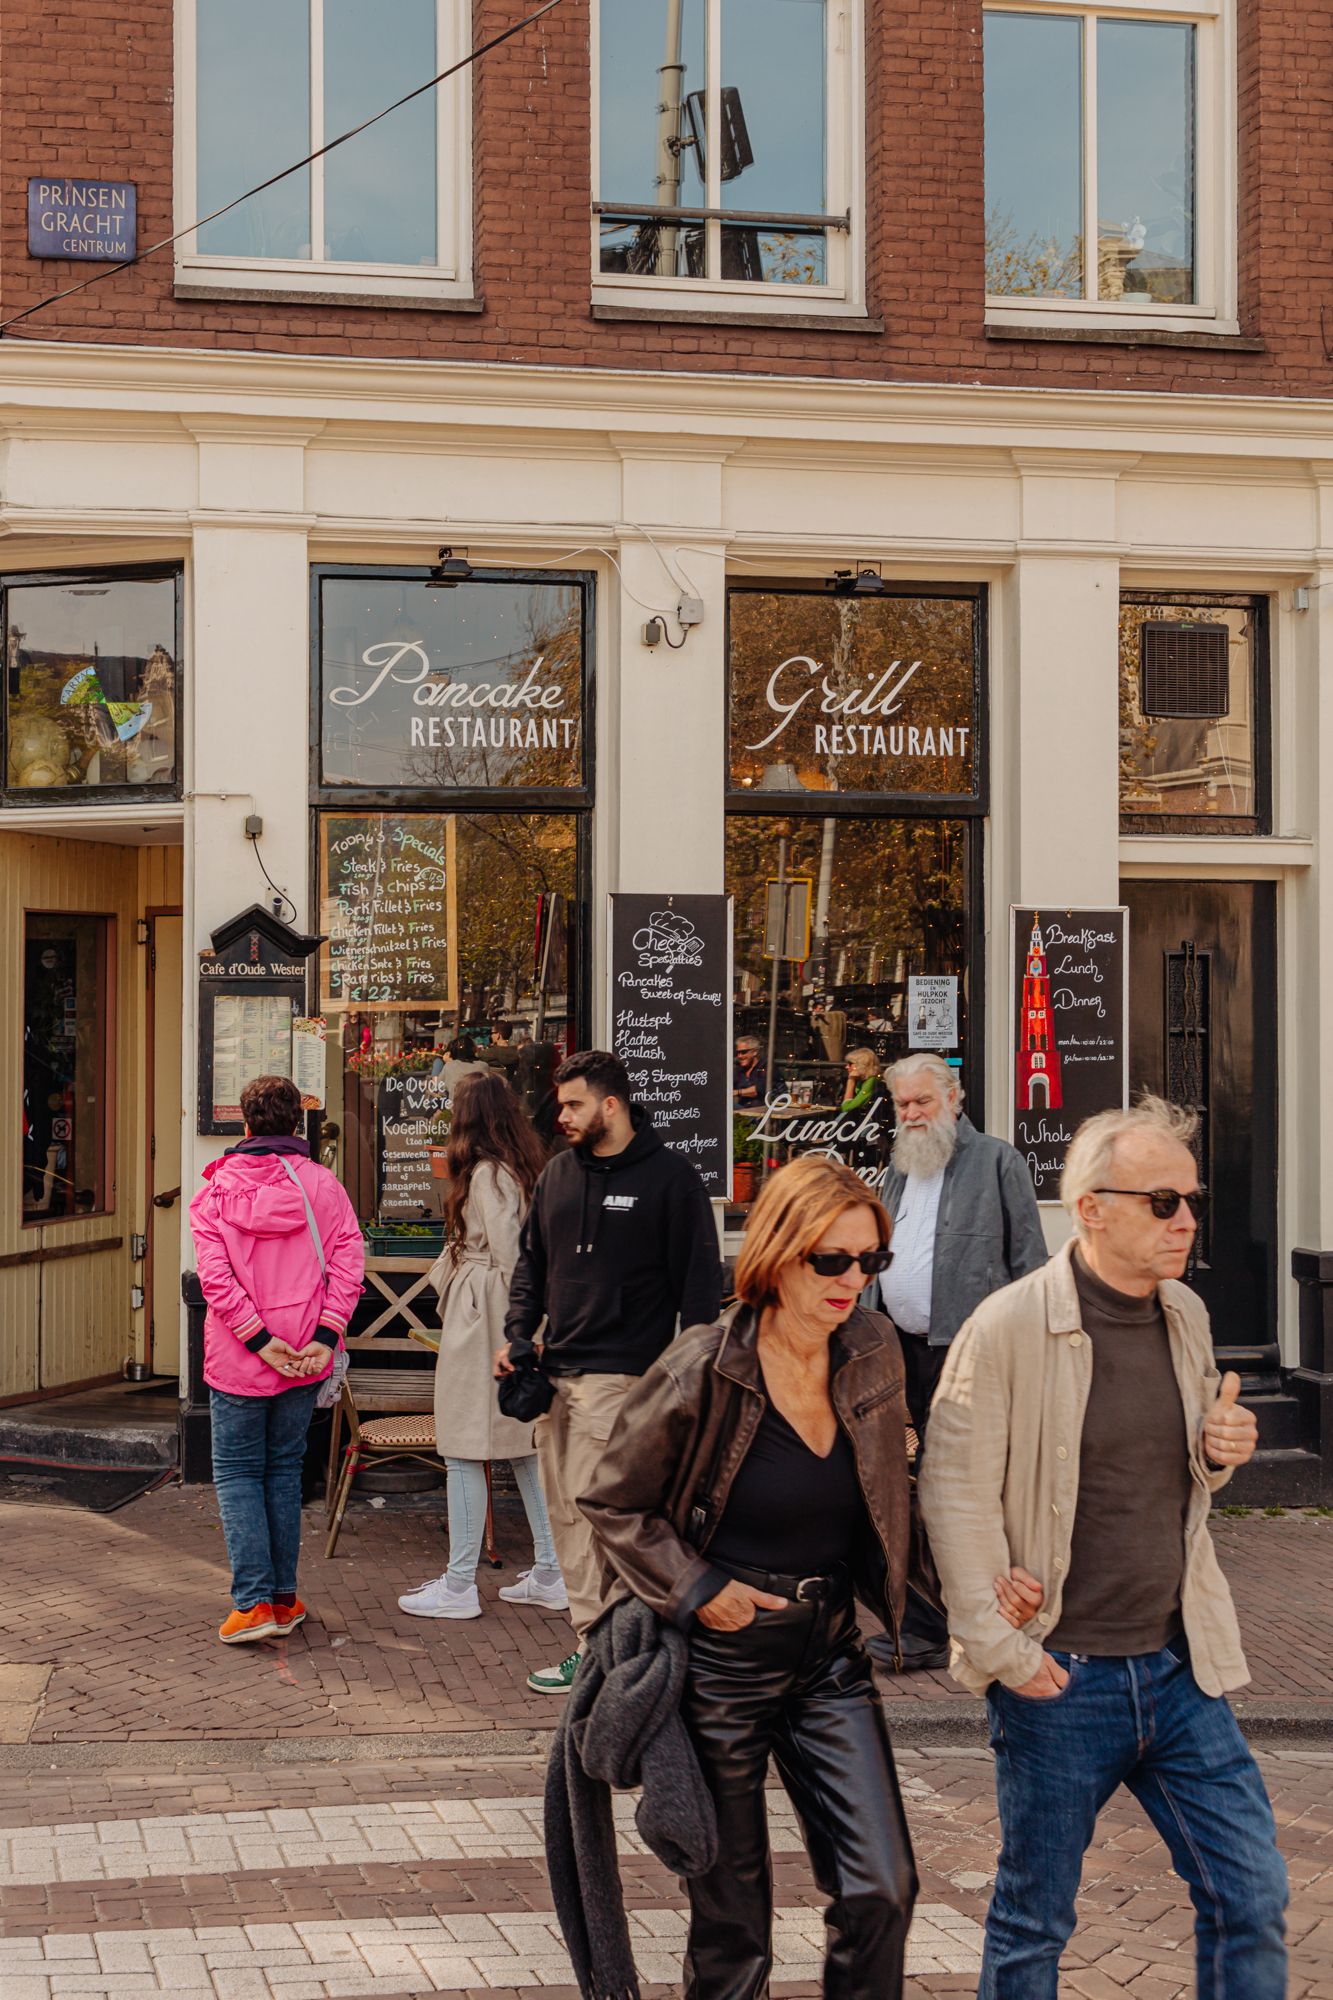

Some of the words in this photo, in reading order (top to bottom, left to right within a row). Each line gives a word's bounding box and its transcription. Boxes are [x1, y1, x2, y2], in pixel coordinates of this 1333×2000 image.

[40, 184, 125, 209] PRINSEN
[41, 211, 125, 235] GRACHT
[62, 239, 126, 254] CENTRUM
[328, 640, 565, 709] Pancake
[745, 655, 922, 750] Grill
[410, 717, 574, 748] RESTAURANT
[815, 724, 970, 757] RESTAURANT
[340, 857, 377, 874] Steak
[391, 858, 420, 873] Fries
[339, 882, 369, 895] Fish
[413, 899, 442, 914] Fries
[408, 921, 435, 934] Fries
[422, 936, 447, 949] Fries
[1045, 924, 1118, 952] Breakfast
[200, 963, 225, 975] Cafe
[229, 963, 266, 975] d'Oude
[270, 963, 306, 975] Wester
[406, 957, 431, 969] Fries
[1054, 955, 1104, 983] Lunch
[407, 970, 435, 984] Fries
[640, 988, 673, 999] Sweet
[1053, 988, 1106, 1017] Dinner
[618, 1046, 666, 1061] Goulash
[386, 1076, 404, 1092] De
[406, 1076, 445, 1093] Oude
[627, 1070, 649, 1087] eef
[407, 1095, 453, 1110] Weste
[654, 1107, 701, 1121] mussels
[746, 1091, 884, 1142] Lunch
[1019, 1118, 1072, 1144] Whole
[1026, 1151, 1065, 1186] Availa
